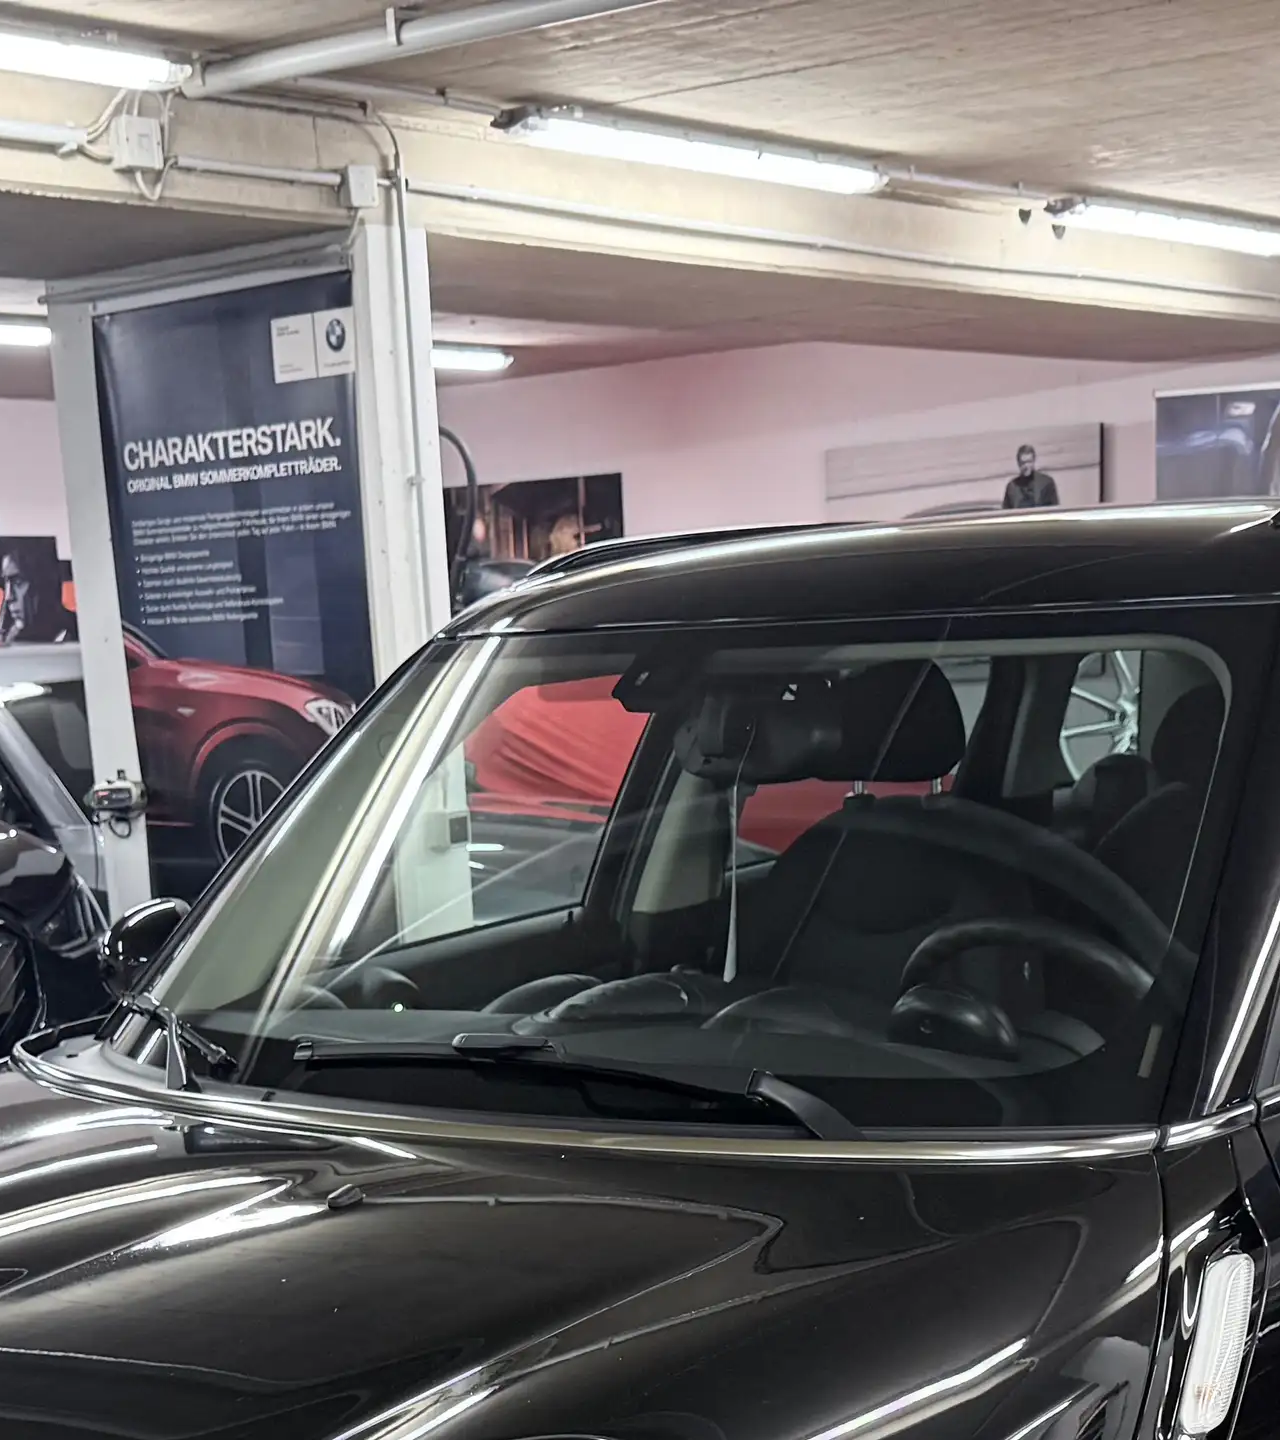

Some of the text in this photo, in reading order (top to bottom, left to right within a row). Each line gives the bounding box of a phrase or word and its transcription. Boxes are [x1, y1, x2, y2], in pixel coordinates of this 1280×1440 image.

[123, 416, 341, 471] CHARAKTERSTARK.
[127, 456, 342, 493] ORIGINAL BMW SOMMERKOMPLETTRÄDER.
